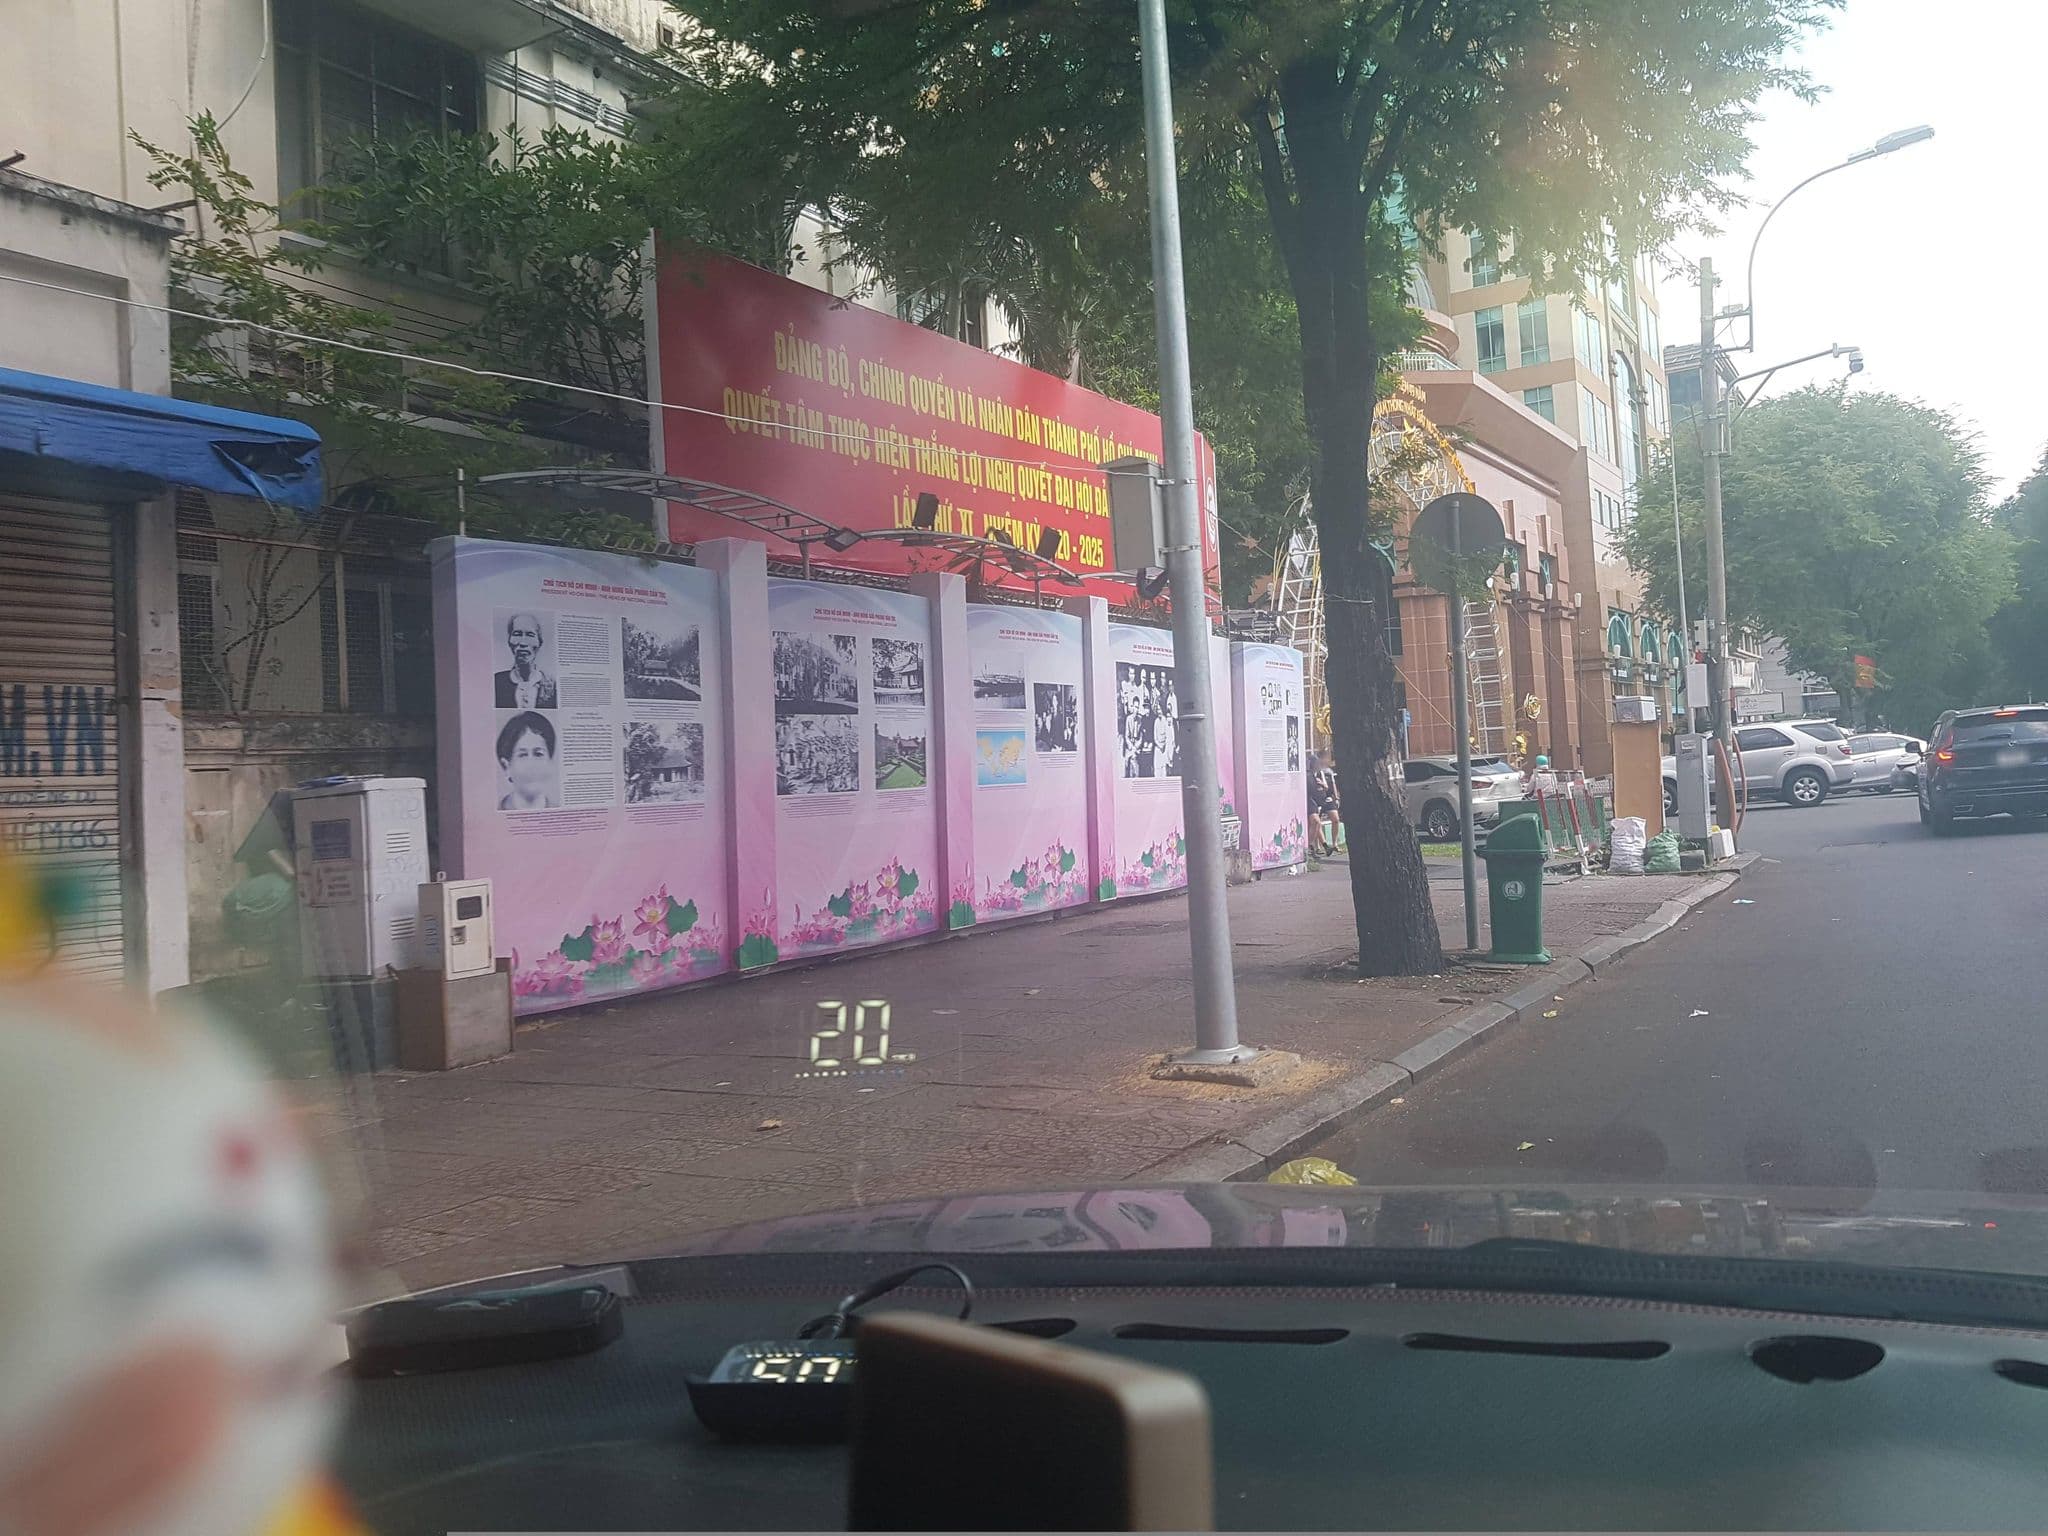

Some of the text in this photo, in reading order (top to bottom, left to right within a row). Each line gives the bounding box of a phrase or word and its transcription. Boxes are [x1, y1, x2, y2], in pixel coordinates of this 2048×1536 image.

[774, 329, 823, 382] ĐẢNG
[858, 357, 906, 407] CHÍNH
[908, 372, 956, 422] QUYỀN
[957, 386, 977, 428] VÀ
[978, 396, 1014, 438] NHÂN
[1015, 405, 1041, 446] DÂN
[1042, 416, 1078, 458] THÀNH
[1080, 425, 1101, 465] PHỐ
[723, 385, 782, 440] QUYẾT
[786, 398, 825, 450] TÂM
[828, 414, 871, 466] THỰC
[874, 424, 911, 475] HIỆN
[912, 429, 959, 482] THẮNG
[962, 450, 983, 493] LỢI
[985, 457, 1016, 502] NGHỊ
[1018, 462, 1053, 504] QUYẾT
[1055, 475, 1075, 514] ĐẠI
[1075, 477, 1094, 520] HỘI
[1025, 517, 1041, 555] KỲ
[1079, 534, 1105, 568] 2025
[810, 998, 892, 1068] 20
